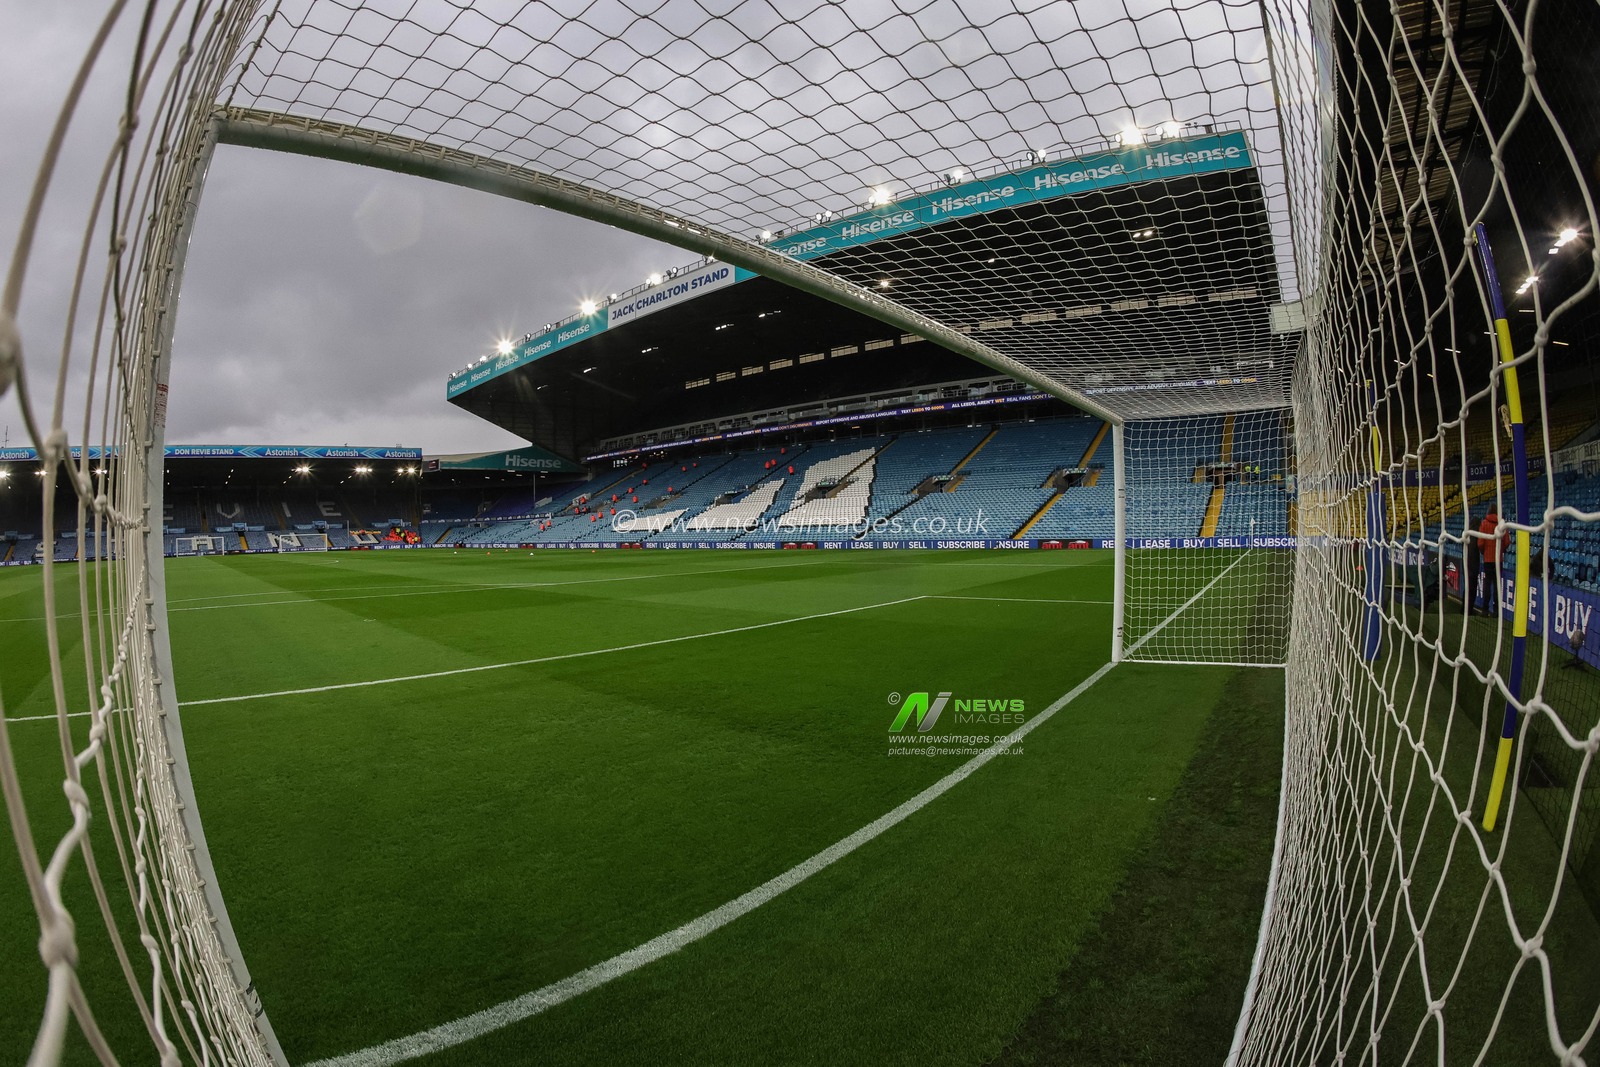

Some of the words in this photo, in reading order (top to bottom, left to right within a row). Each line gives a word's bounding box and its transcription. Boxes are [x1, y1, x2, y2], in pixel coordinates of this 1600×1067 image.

[1146, 146, 1240, 170] Hisense
[1034, 163, 1125, 191] Hisense
[932, 186, 1015, 215] Hisense
[842, 211, 915, 240] Hisense
[612, 303, 635, 320] JACK
[636, 282, 689, 310] CHARLTON
[691, 268, 729, 290] STAND
[558, 323, 590, 344] Hisense
[524, 340, 552, 358] Hisense
[495, 354, 519, 370] Hisense
[470, 368, 491, 382] Hisense
[450, 380, 468, 394] Hisense
[0, 450, 29, 460] Astonish
[265, 448, 298, 456] Astonish
[326, 449, 359, 457] Astonish
[385, 450, 416, 458] Astonish
[505, 454, 562, 468] Hisense
[1470, 466, 1487, 476] BOXT
[996, 541, 1029, 549] INSURE
[1140, 539, 1170, 548] LEASE
[1183, 539, 1205, 548] BUY
[1217, 538, 1241, 548] SELL
[1501, 578, 1537, 622] LEE
[1554, 594, 1592, 646] BUY
